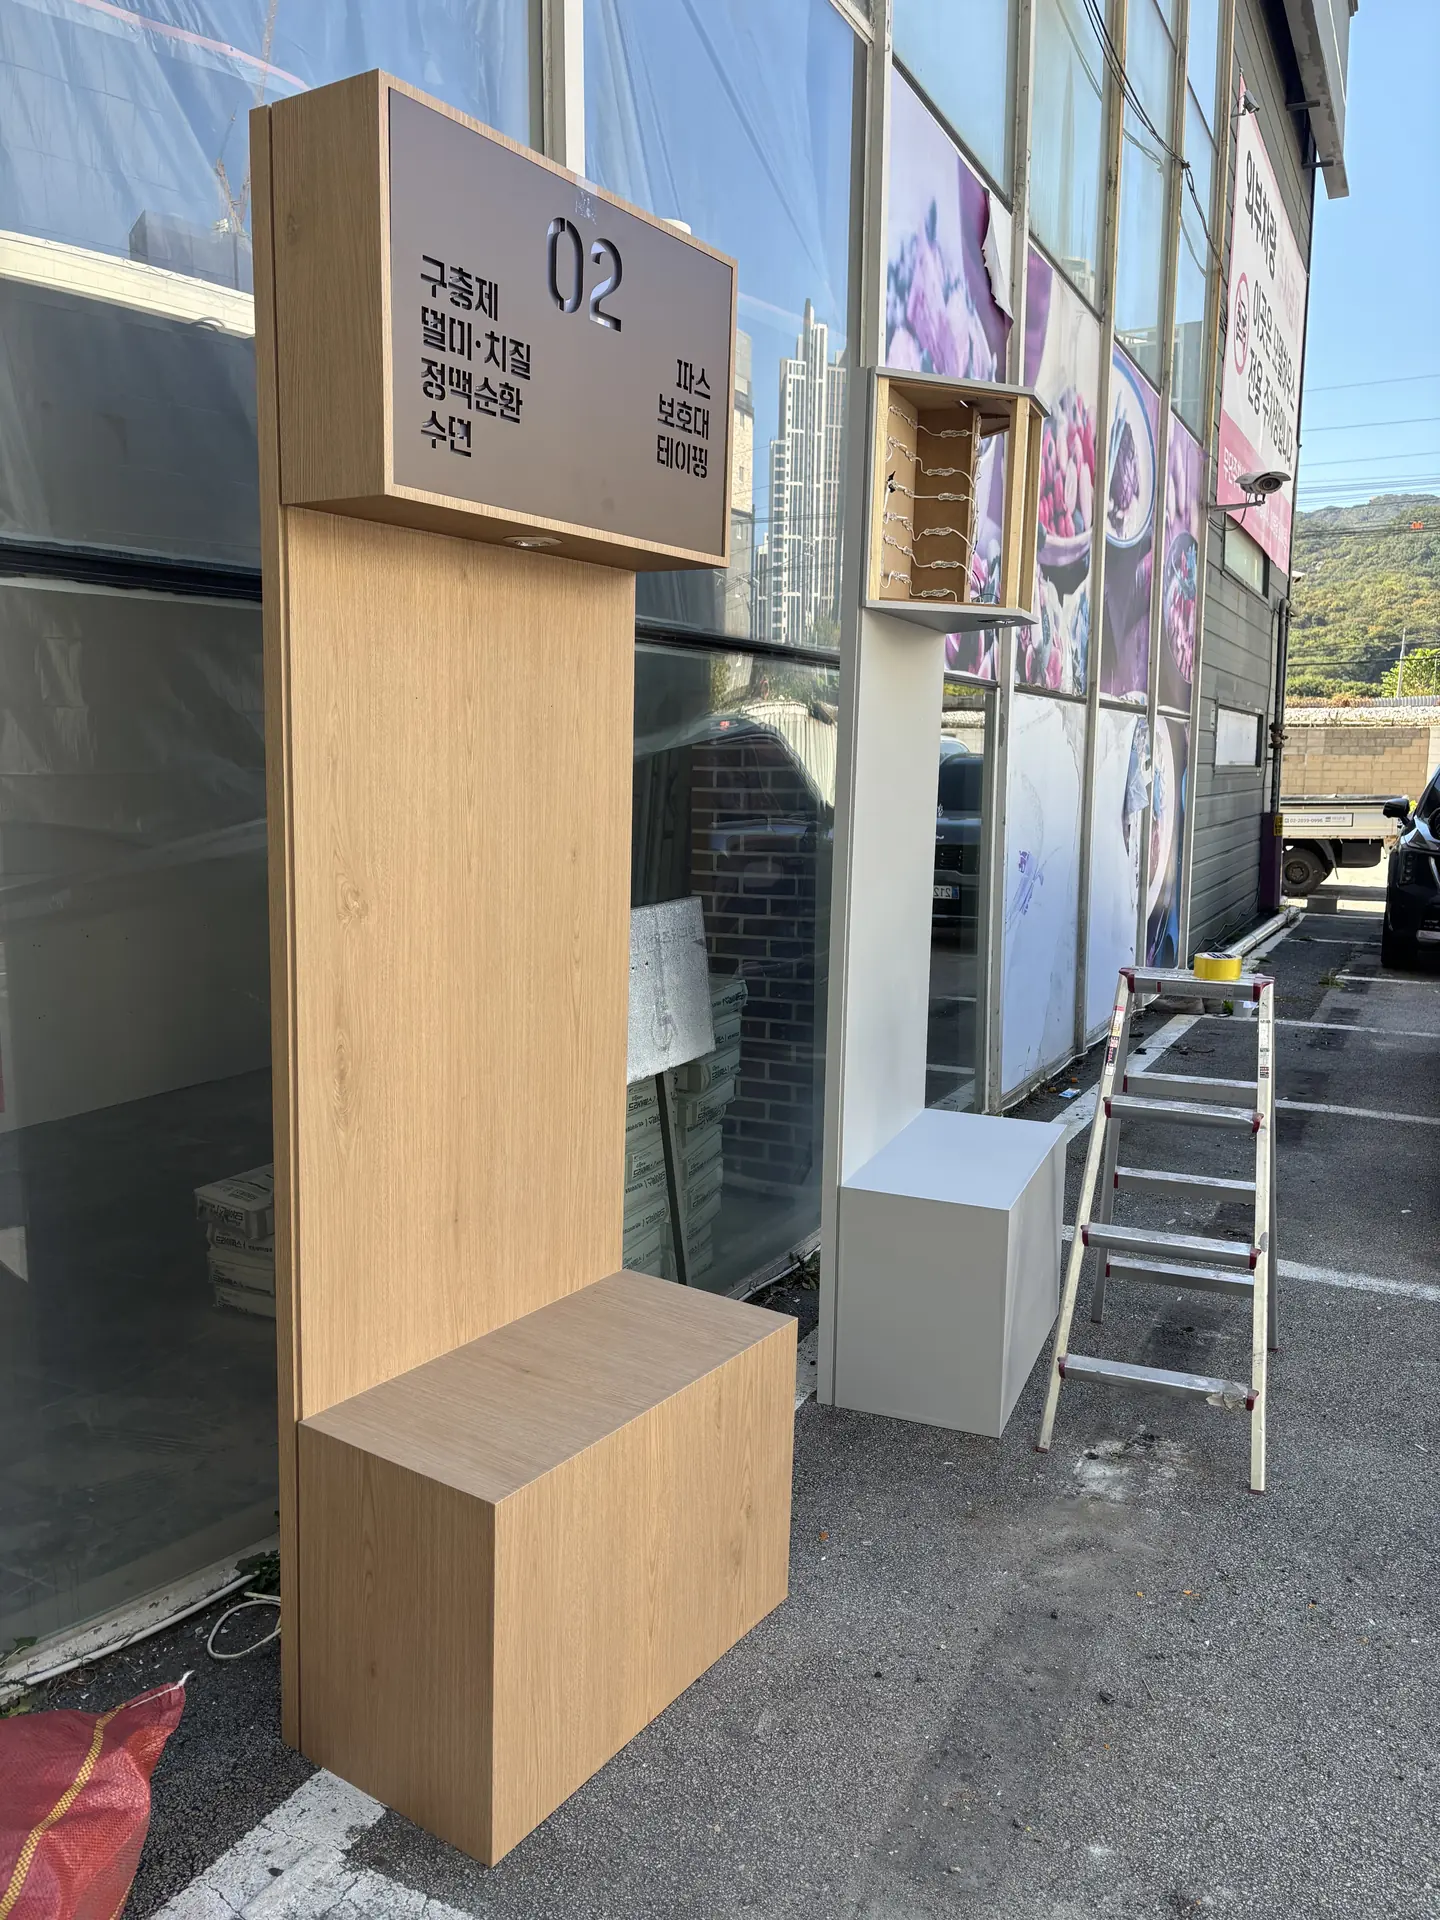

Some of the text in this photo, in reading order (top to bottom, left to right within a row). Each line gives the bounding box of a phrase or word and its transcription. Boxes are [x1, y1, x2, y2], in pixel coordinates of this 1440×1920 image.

[1245, 150, 1277, 280] 외부차량
[421, 254, 498, 321] 구충제
[546, 217, 623, 332] 02
[421, 305, 531, 381] 멀미·치질
[1253, 279, 1296, 412] 이곳은 모델하우스
[421, 356, 523, 424] 정맥순환
[676, 358, 711, 400] 파스
[1248, 347, 1263, 415] 전용
[420, 410, 472, 458] 수면
[657, 393, 710, 441] 보호대
[657, 434, 708, 479] 테이핑
